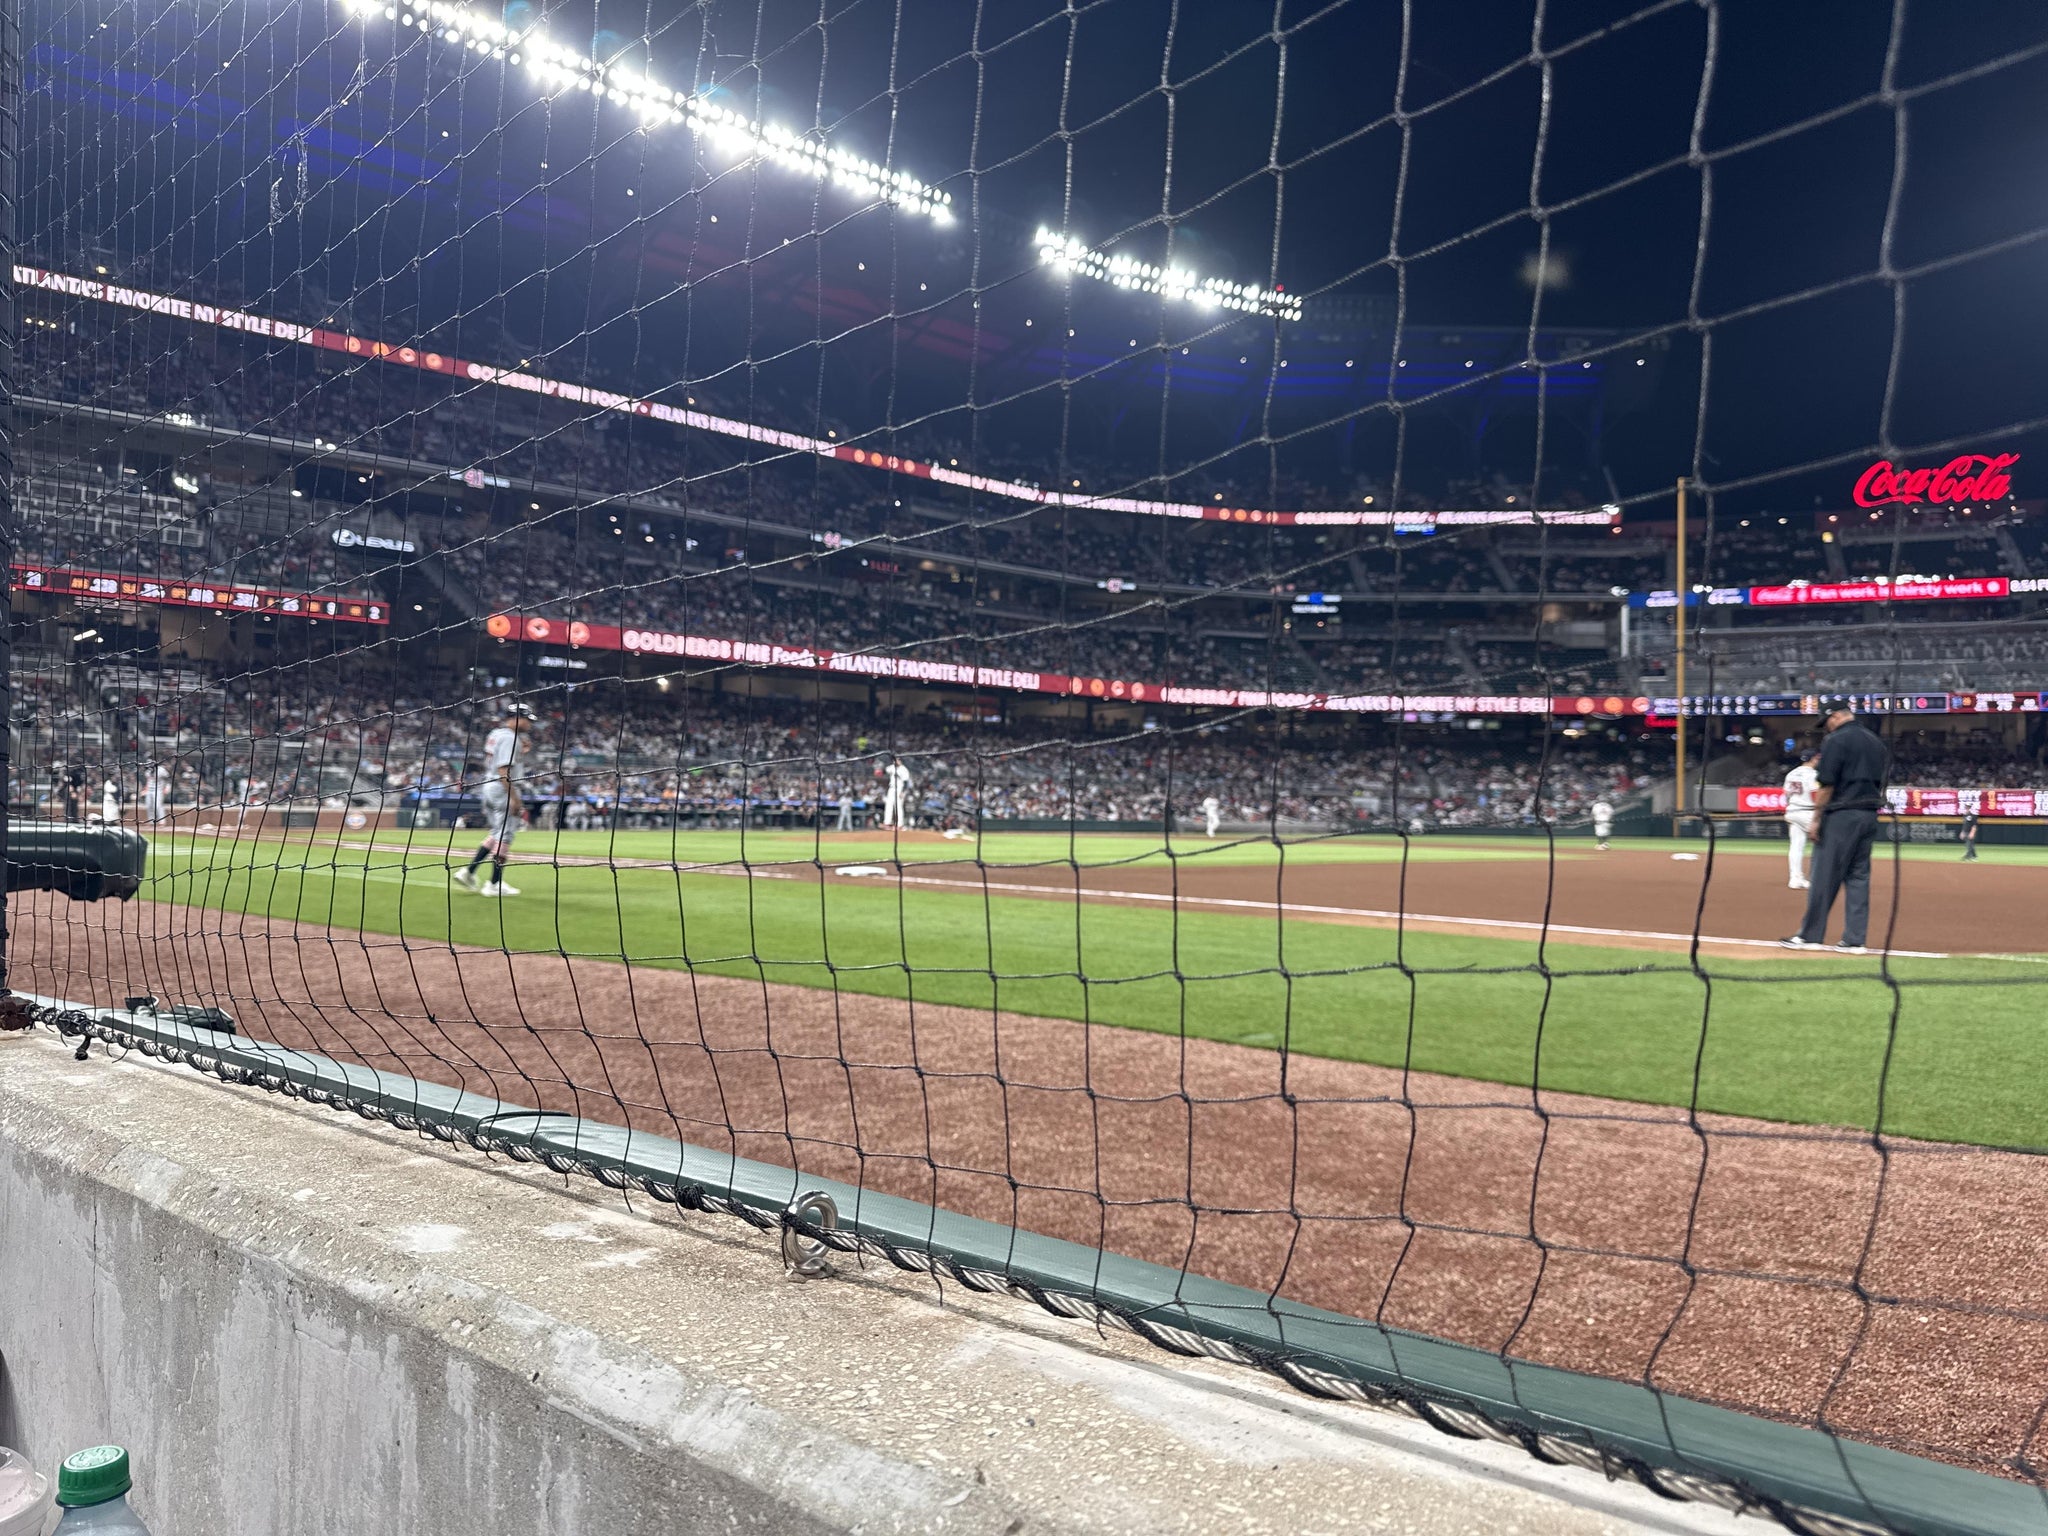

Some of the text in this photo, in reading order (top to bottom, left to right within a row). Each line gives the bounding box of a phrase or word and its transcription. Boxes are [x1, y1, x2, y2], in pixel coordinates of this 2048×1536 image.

[107, 285, 192, 318] FAVORITE
[194, 303, 219, 323] NY
[221, 310, 271, 335] STYLE
[274, 321, 313, 344] DELI
[1853, 453, 2020, 507] Coca-Cola
[355, 534, 414, 552] LEXUS
[1811, 587, 1838, 600] Fan
[1839, 585, 1877, 598] work
[1894, 583, 1942, 597] thirsty
[1944, 582, 1983, 594] work
[898, 659, 958, 682] FAVORITE
[959, 665, 974, 683] NY
[977, 668, 1012, 687] STYLE
[1013, 672, 1040, 689] DELI
[1455, 697, 1475, 711] NY
[1475, 697, 1519, 712] STYLE
